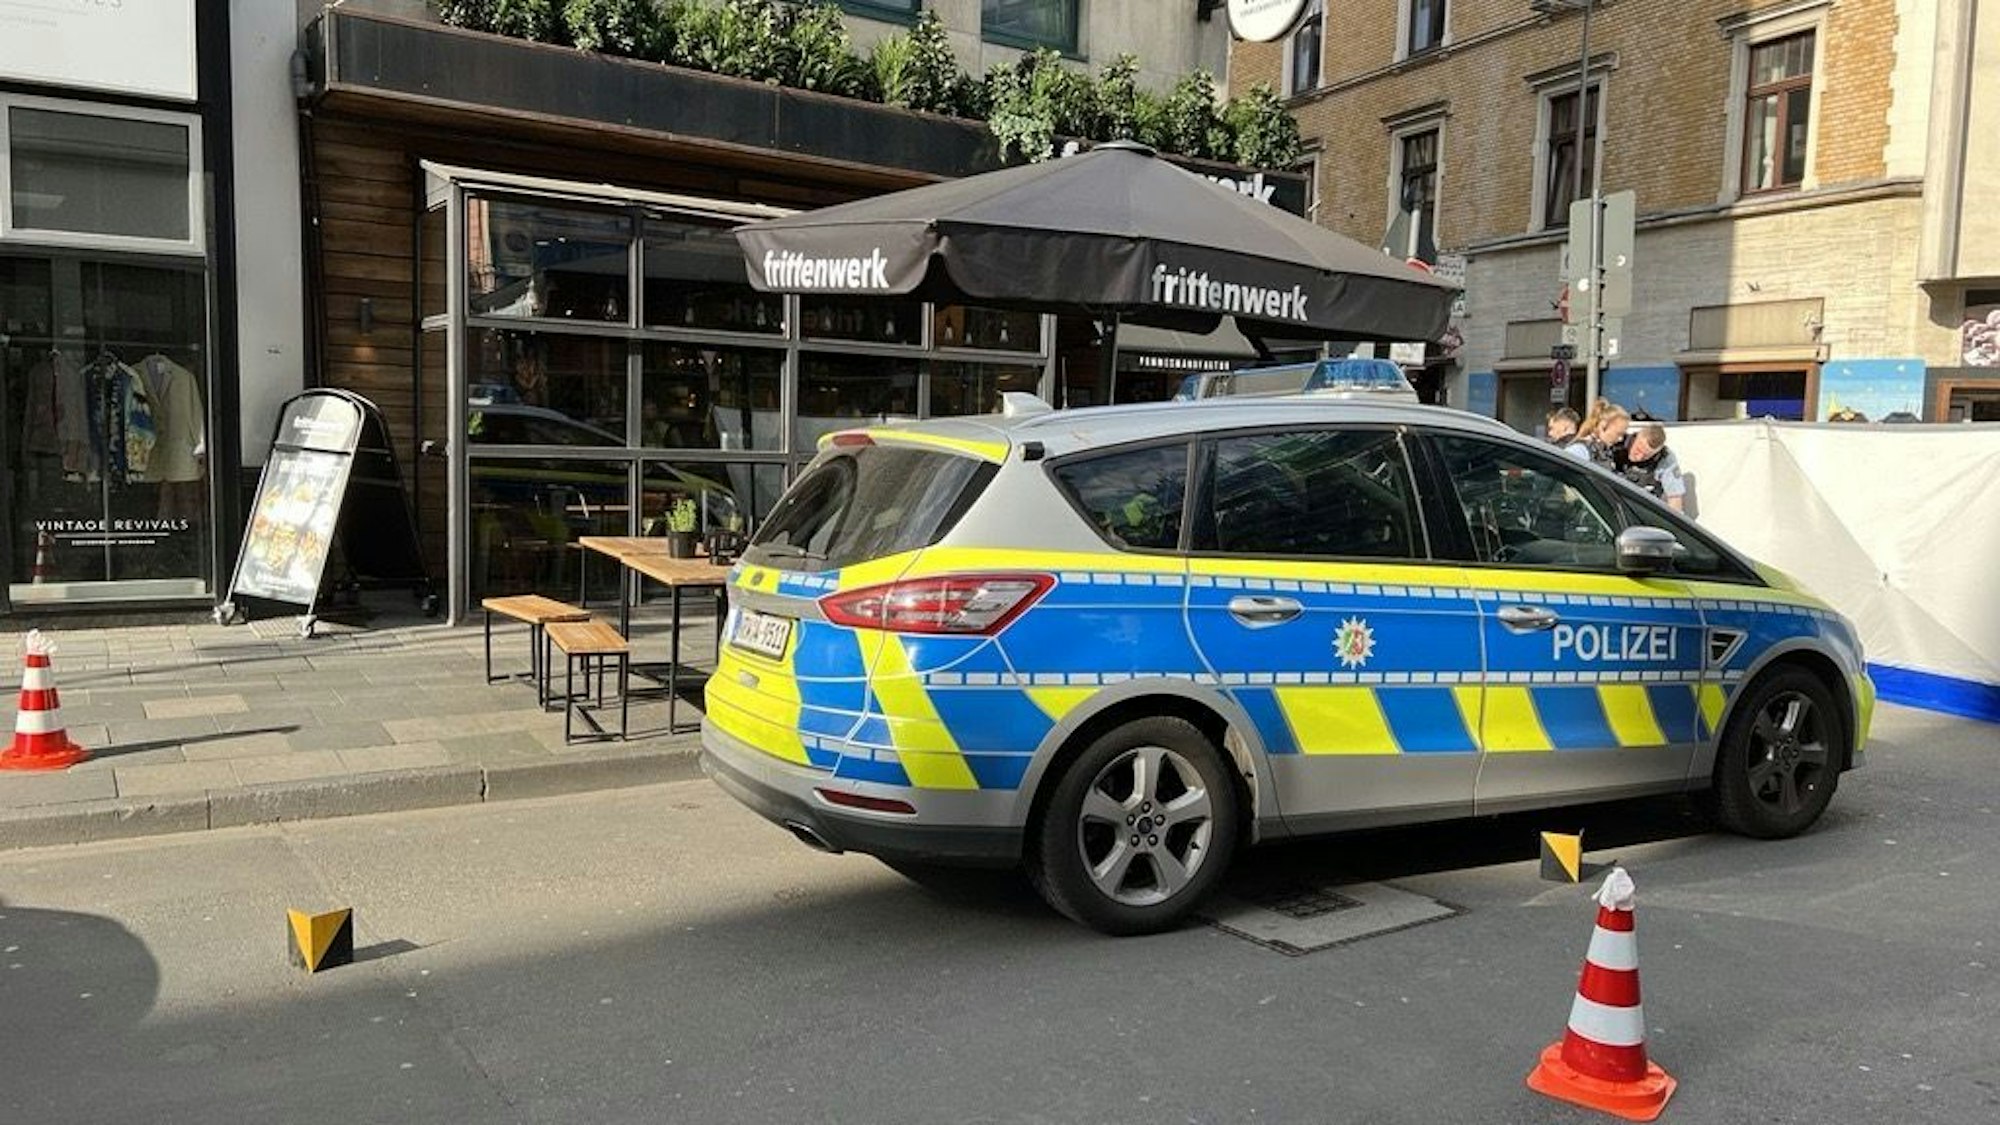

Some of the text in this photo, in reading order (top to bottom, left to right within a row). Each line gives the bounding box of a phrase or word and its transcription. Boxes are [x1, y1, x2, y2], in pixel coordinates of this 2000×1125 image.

[763, 247, 890, 289] frittenwerk
[1152, 263, 1309, 322] frittenwerk
[35, 519, 189, 532] VINTAGE REVIVALS
[1553, 623, 1677, 661] POLIZEI
